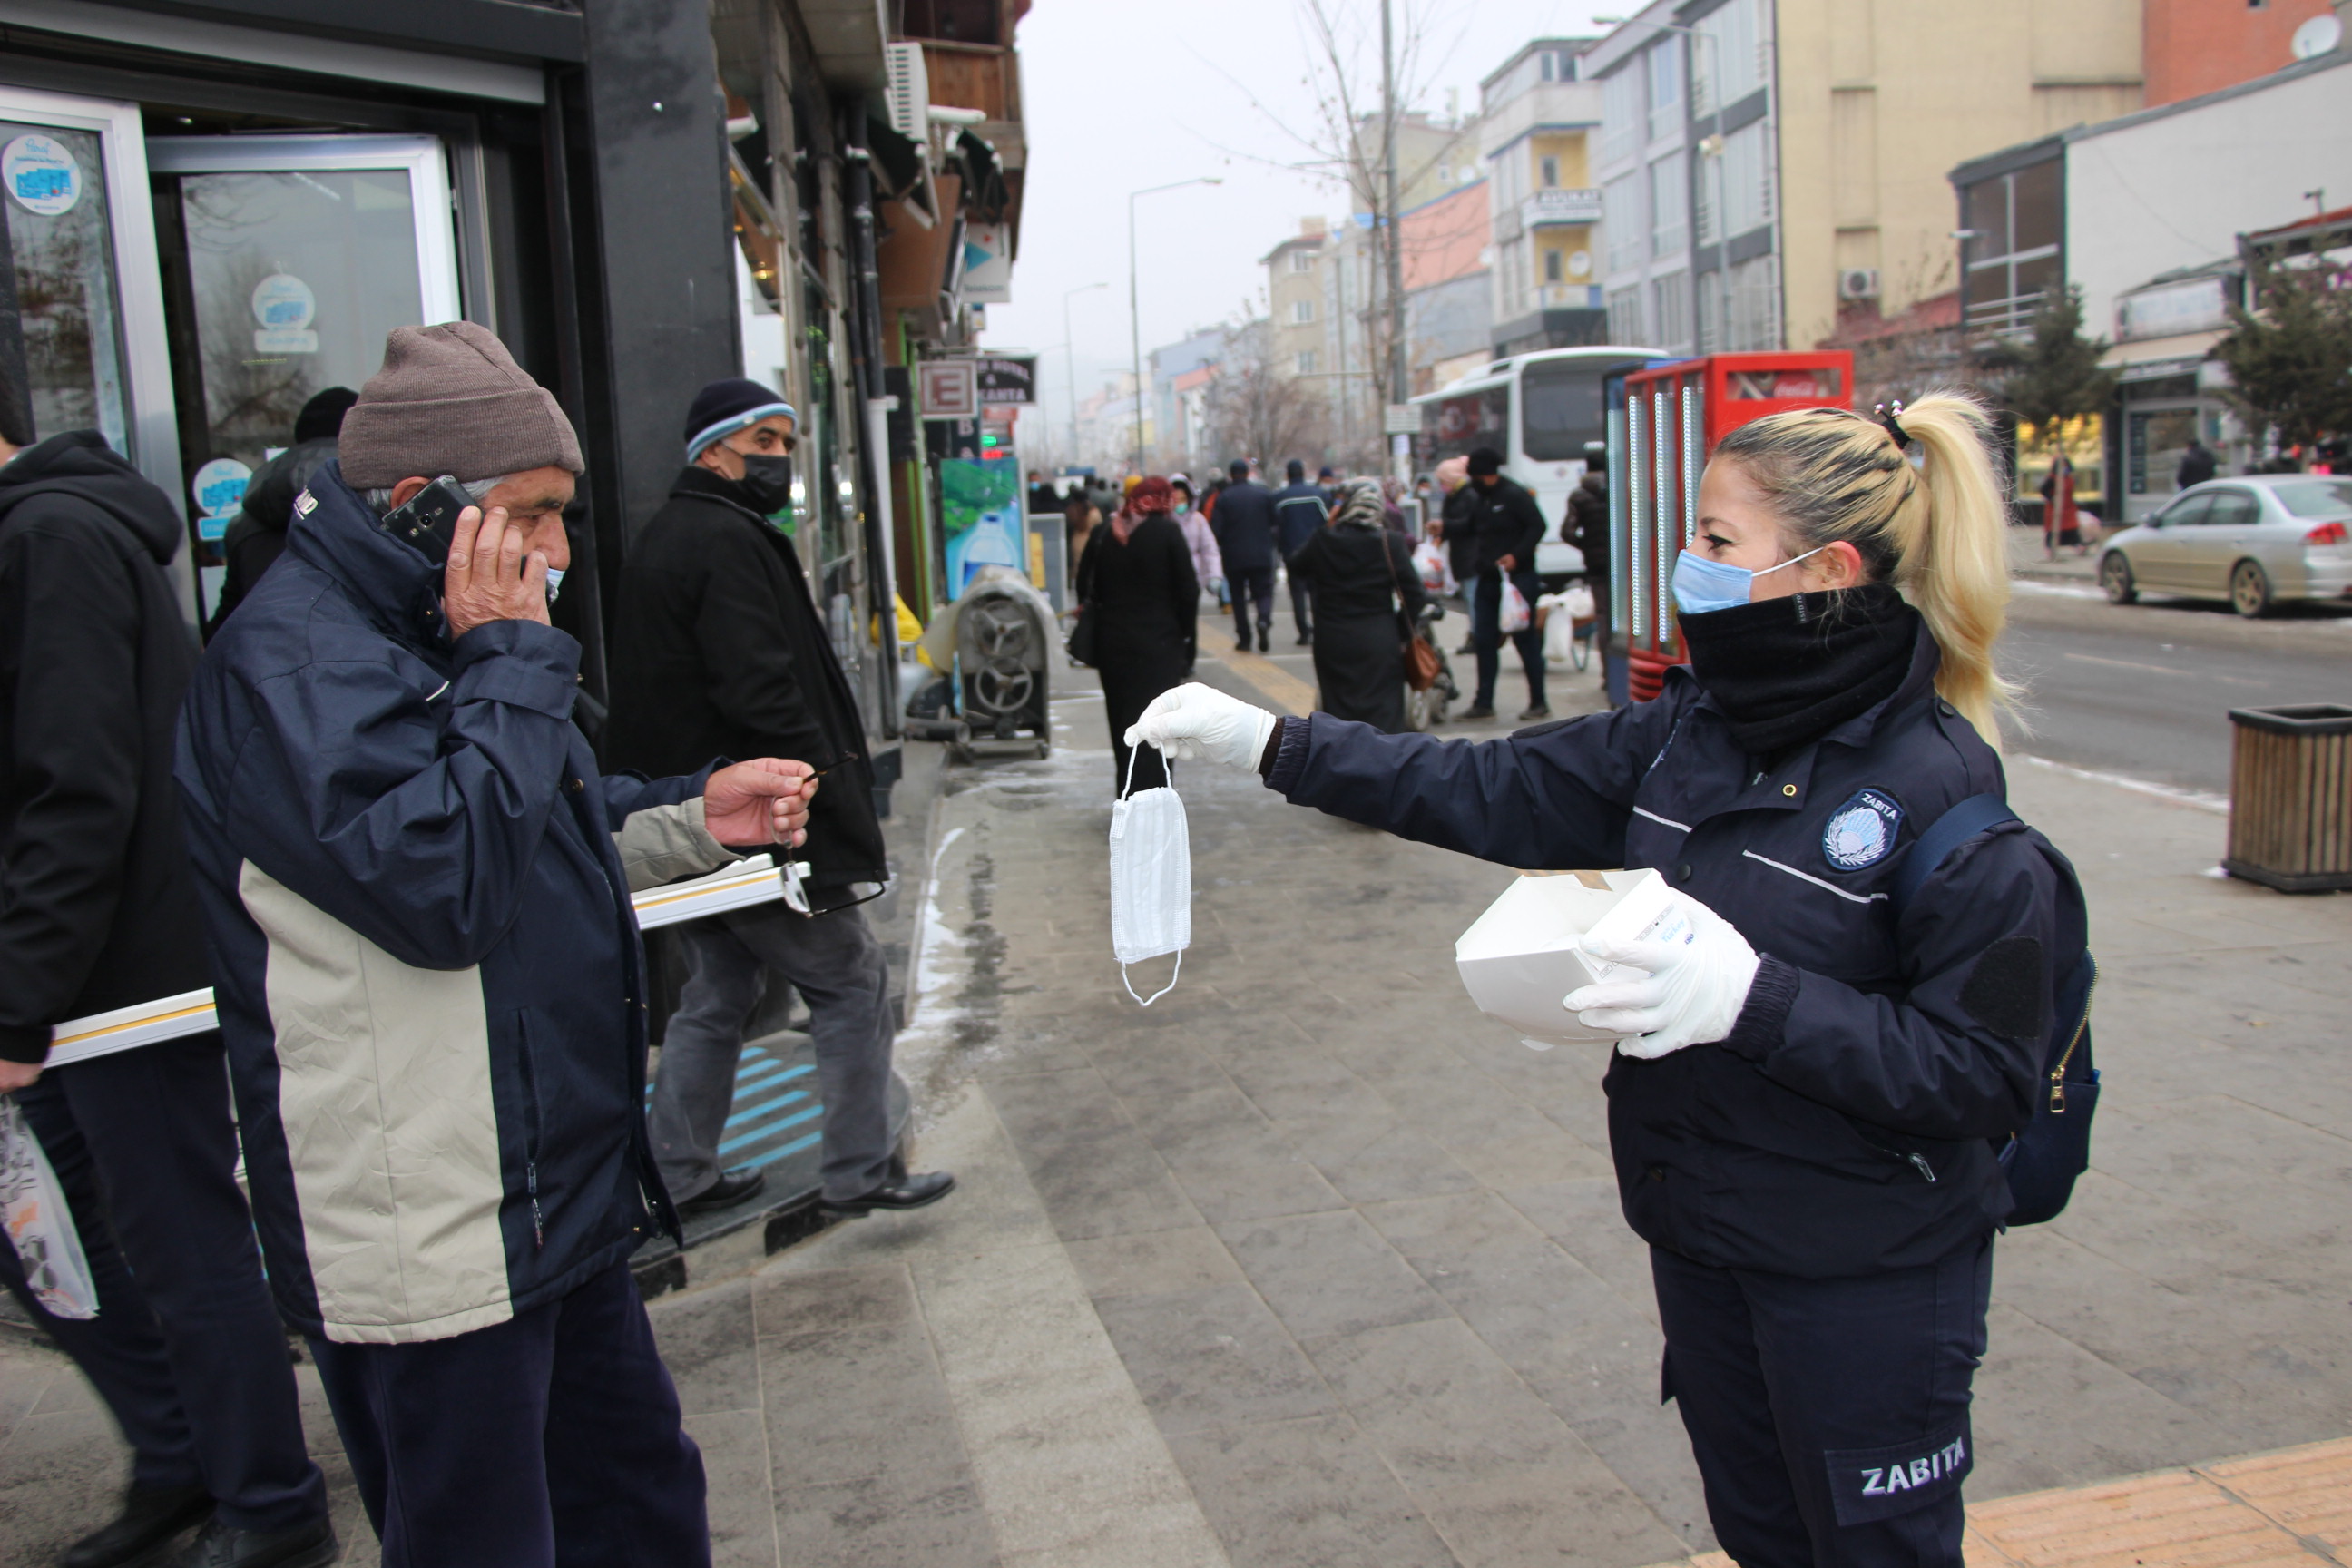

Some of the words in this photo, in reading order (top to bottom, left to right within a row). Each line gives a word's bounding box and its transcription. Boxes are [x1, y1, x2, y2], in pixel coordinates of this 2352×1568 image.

[932, 374, 962, 406] E
[1860, 793, 1897, 819] ZABITA
[1662, 918, 1685, 942] Turkey
[1860, 1436, 1965, 1496] ZABITA
